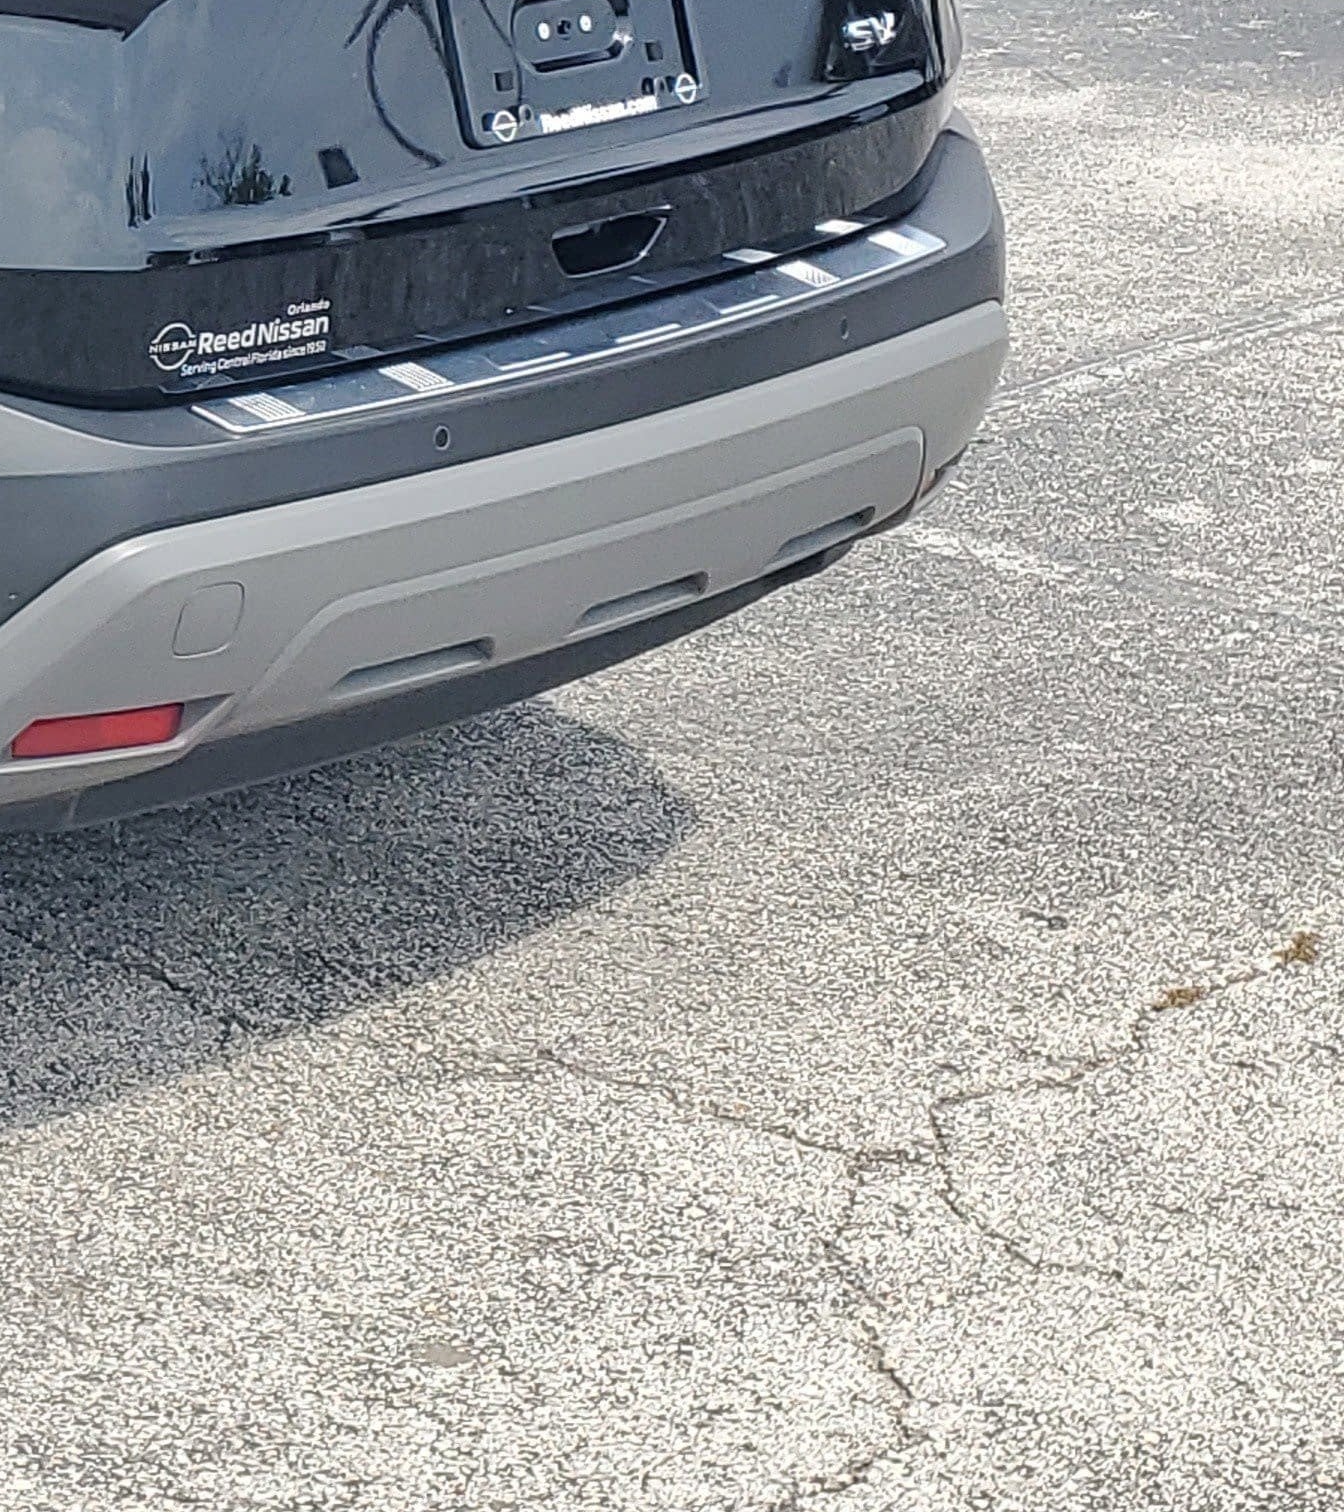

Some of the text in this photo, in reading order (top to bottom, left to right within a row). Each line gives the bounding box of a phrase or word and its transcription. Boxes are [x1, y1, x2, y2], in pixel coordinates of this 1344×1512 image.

[842, 11, 897, 51] SV
[287, 299, 331, 316] Orlando
[148, 339, 198, 354] NISSAN
[180, 360, 217, 377] Serving
[217, 353, 250, 371] Central
[250, 349, 282, 365] Florida
[282, 345, 306, 359] since
